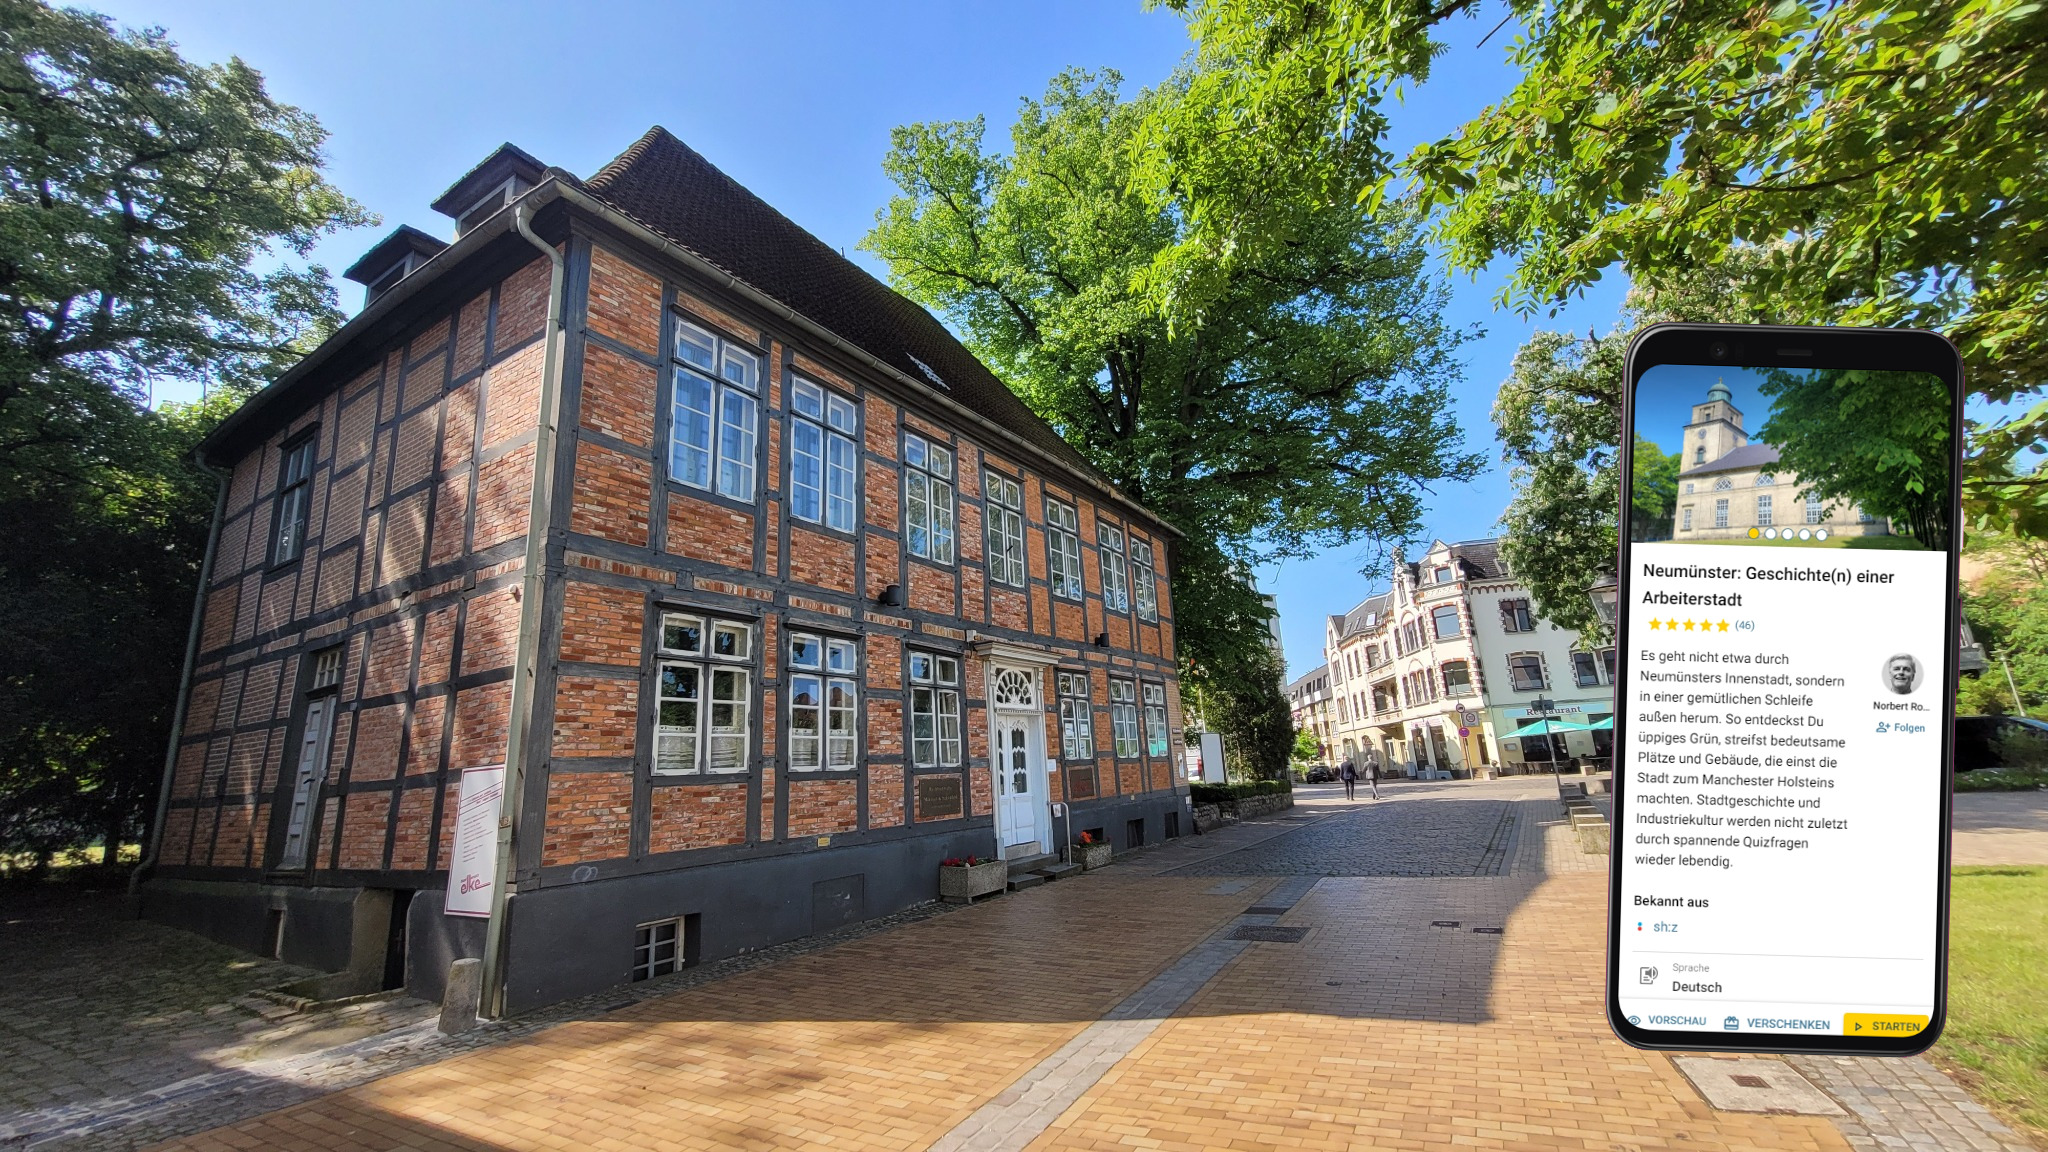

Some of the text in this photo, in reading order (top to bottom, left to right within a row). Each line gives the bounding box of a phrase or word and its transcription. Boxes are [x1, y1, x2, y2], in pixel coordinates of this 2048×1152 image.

[1643, 563, 1895, 586] Neumünster: Geschichte(n) einer
[1642, 590, 1742, 607] Arbeiterstadt
[1735, 620, 1755, 632] (46)
[1641, 650, 1789, 665] Es geht nicht etwa durch
[1640, 670, 1844, 687] Neumünsters Innenstadt, sondern
[1640, 691, 1813, 707] in einer gemütlichen Schleife
[1873, 701, 1908, 711] Norbert
[1639, 711, 1823, 727] außen herum. So entdeckst Du
[1894, 723, 1925, 734] Folgen
[1639, 731, 1846, 748] üppiges Grün, streifst bedeutsame
[1638, 751, 1837, 768] Plätze und Gebäude, die einst die
[1637, 772, 1834, 788] Stadt zum Manchester Holsteins
[1637, 793, 1820, 808] machten. Stadtgeschichte und
[1636, 813, 1848, 830] Industriekultur werden nicht zuletzt
[1636, 833, 1808, 851] durch spannende Quizfragen
[1635, 854, 1733, 869] wieder lebendig.
[1634, 895, 1709, 908] Bekannt aus
[1654, 921, 1678, 932] sh:z
[1672, 963, 1710, 973] Sprache
[1672, 981, 1722, 993] Deutsch
[1648, 1015, 1707, 1026] VORSCHAU
[1747, 1018, 1830, 1030] VERSCHENKEN
[1872, 1021, 1920, 1031] STARTEN
